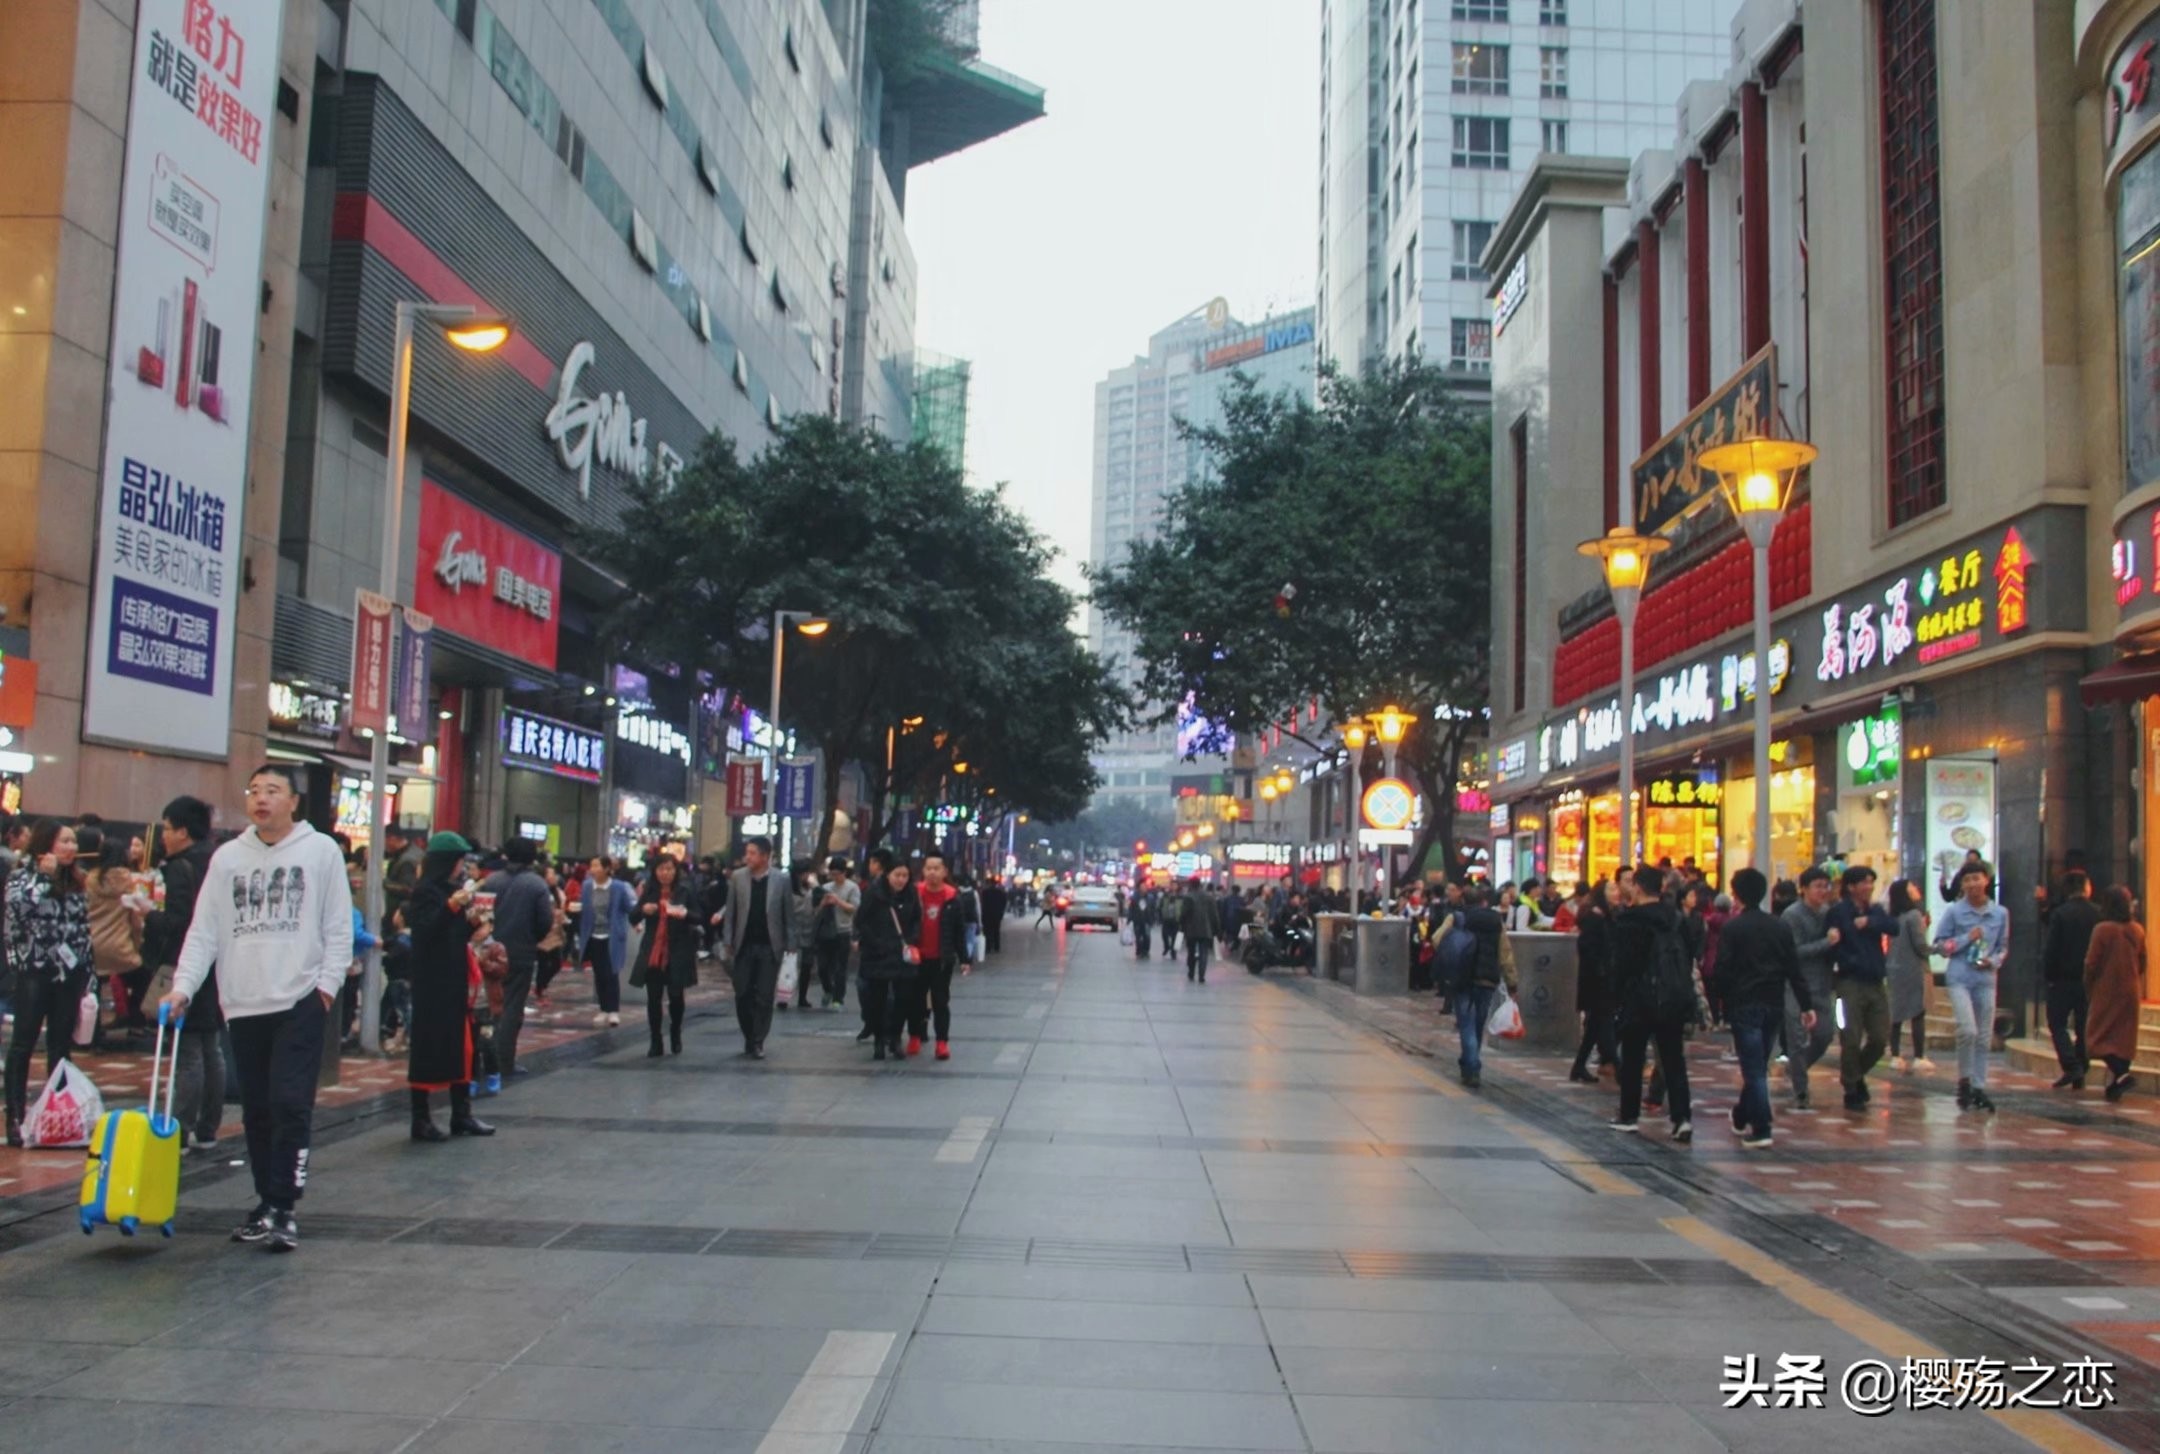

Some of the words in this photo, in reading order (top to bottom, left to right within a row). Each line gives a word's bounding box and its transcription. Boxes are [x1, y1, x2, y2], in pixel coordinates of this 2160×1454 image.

[182, 0, 244, 90] 格力
[148, 29, 262, 166] 就是效果好
[1264, 323, 1312, 352] IMA
[119, 456, 226, 553] 晶弘冰箱
[113, 524, 223, 598] 美食家的冰箱
[1939, 549, 1982, 596] 餐厅
[120, 595, 210, 646] 传承格力品质
[495, 566, 552, 621] 国美电器
